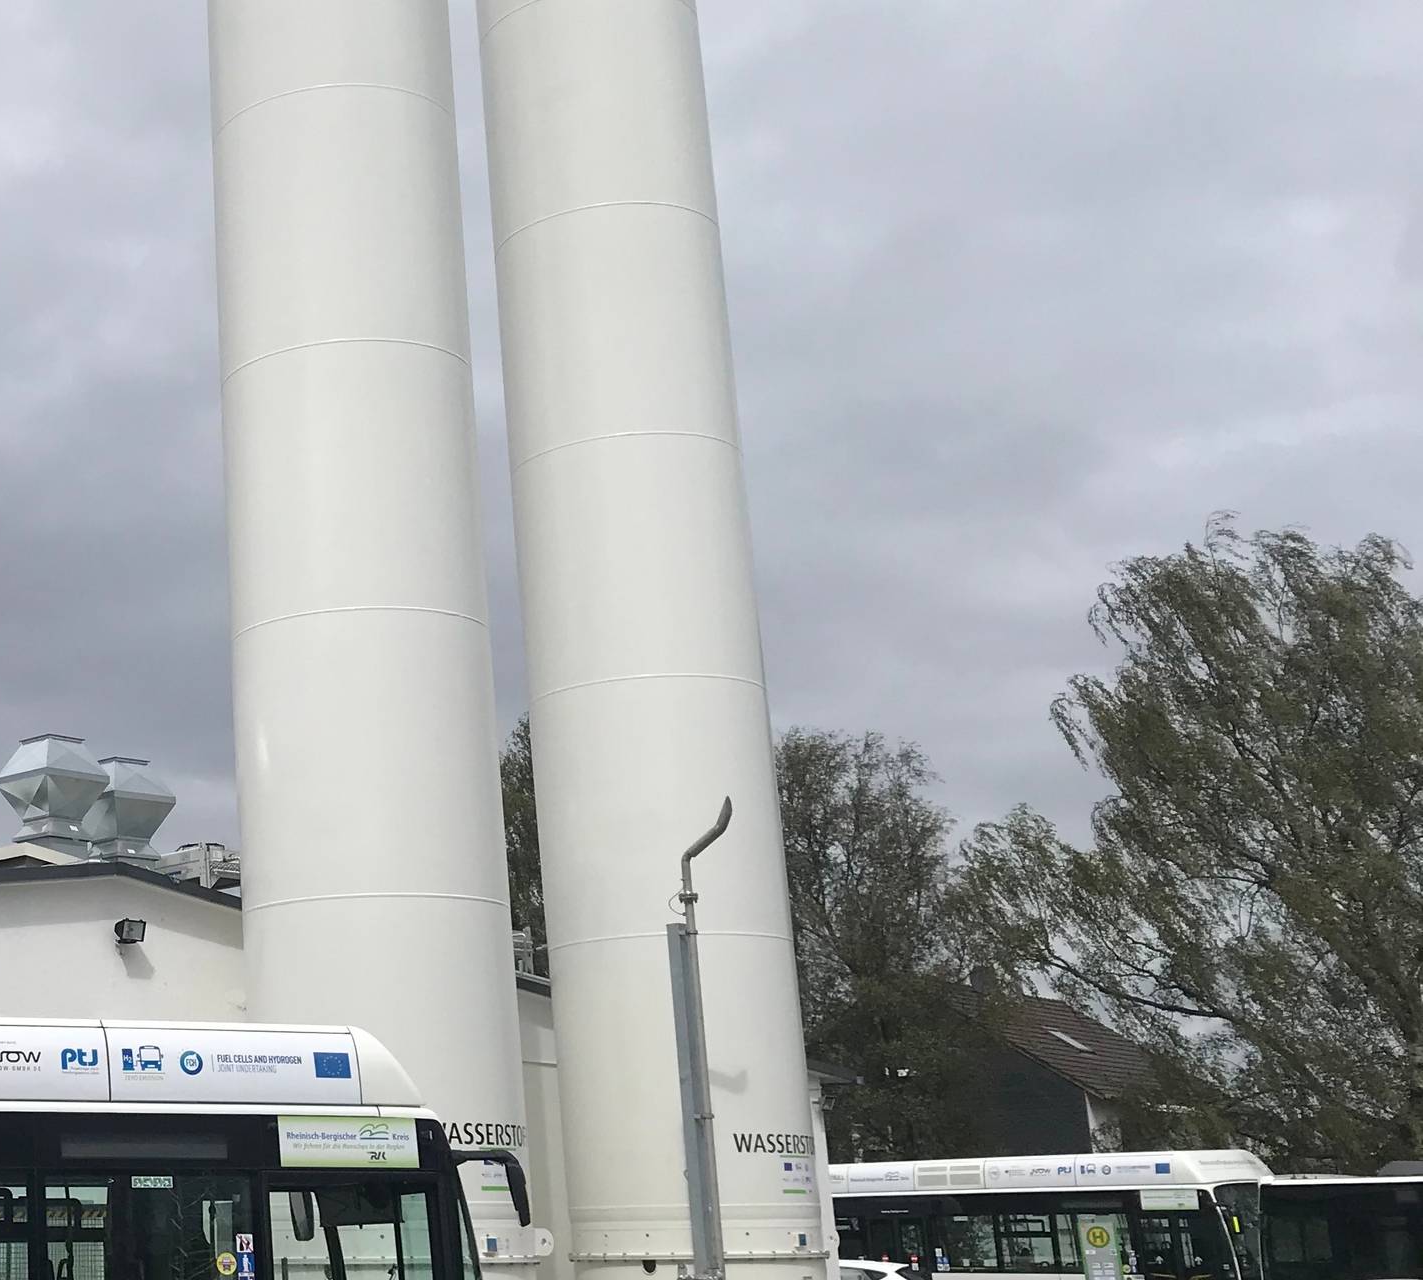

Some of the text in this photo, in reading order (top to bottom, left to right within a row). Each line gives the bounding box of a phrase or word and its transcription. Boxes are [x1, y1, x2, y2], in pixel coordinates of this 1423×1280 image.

[217, 1054, 302, 1065] FUEL CELLS AND HYDROGEN
[286, 1131, 409, 1142] Rheinisch-Bergischer Kreis
